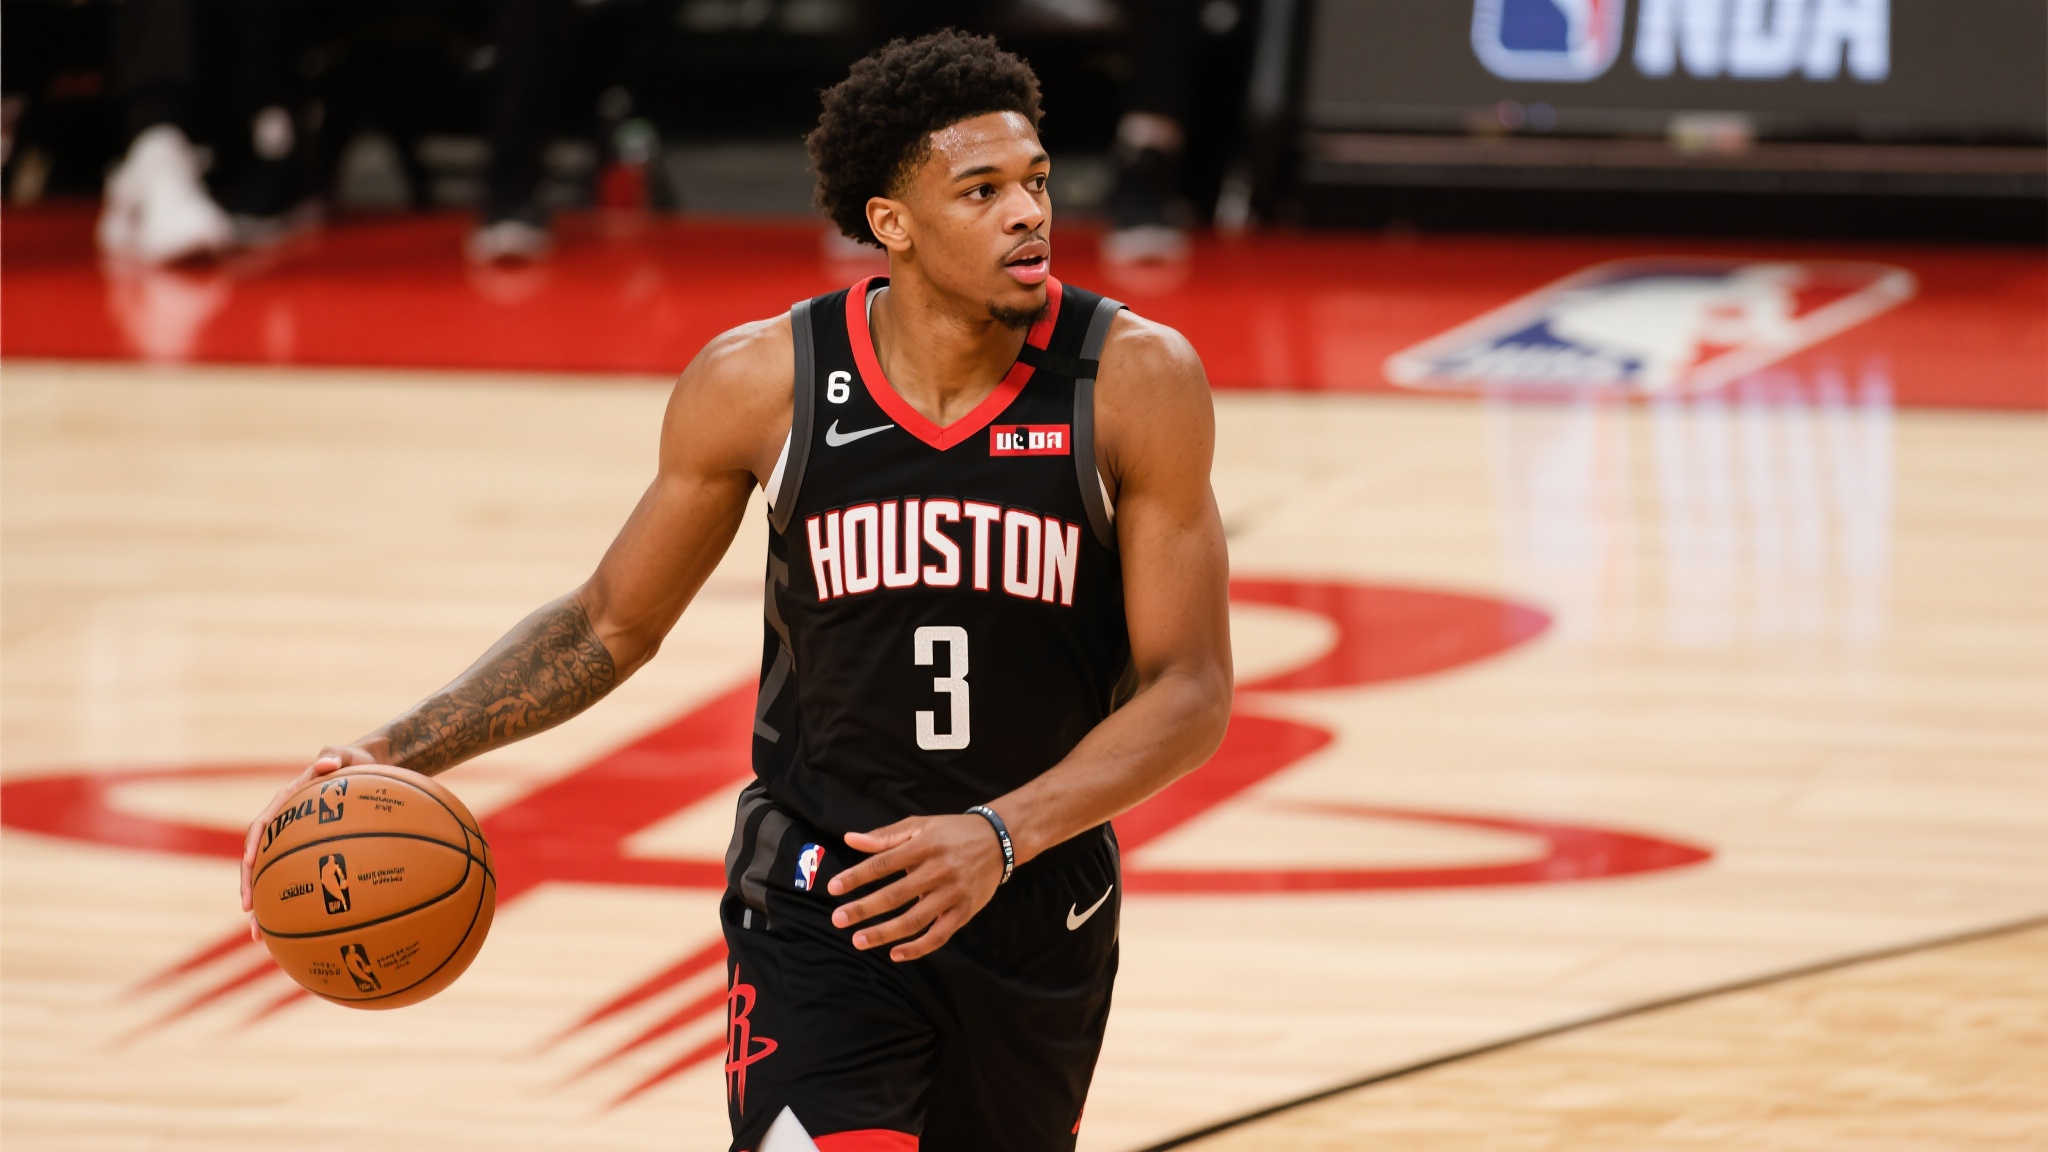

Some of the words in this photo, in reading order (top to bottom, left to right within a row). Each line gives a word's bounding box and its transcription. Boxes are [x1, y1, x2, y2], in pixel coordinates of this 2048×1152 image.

[826, 371, 851, 403] 6
[806, 498, 1081, 607] HOUSTON
[914, 626, 970, 750] 3
